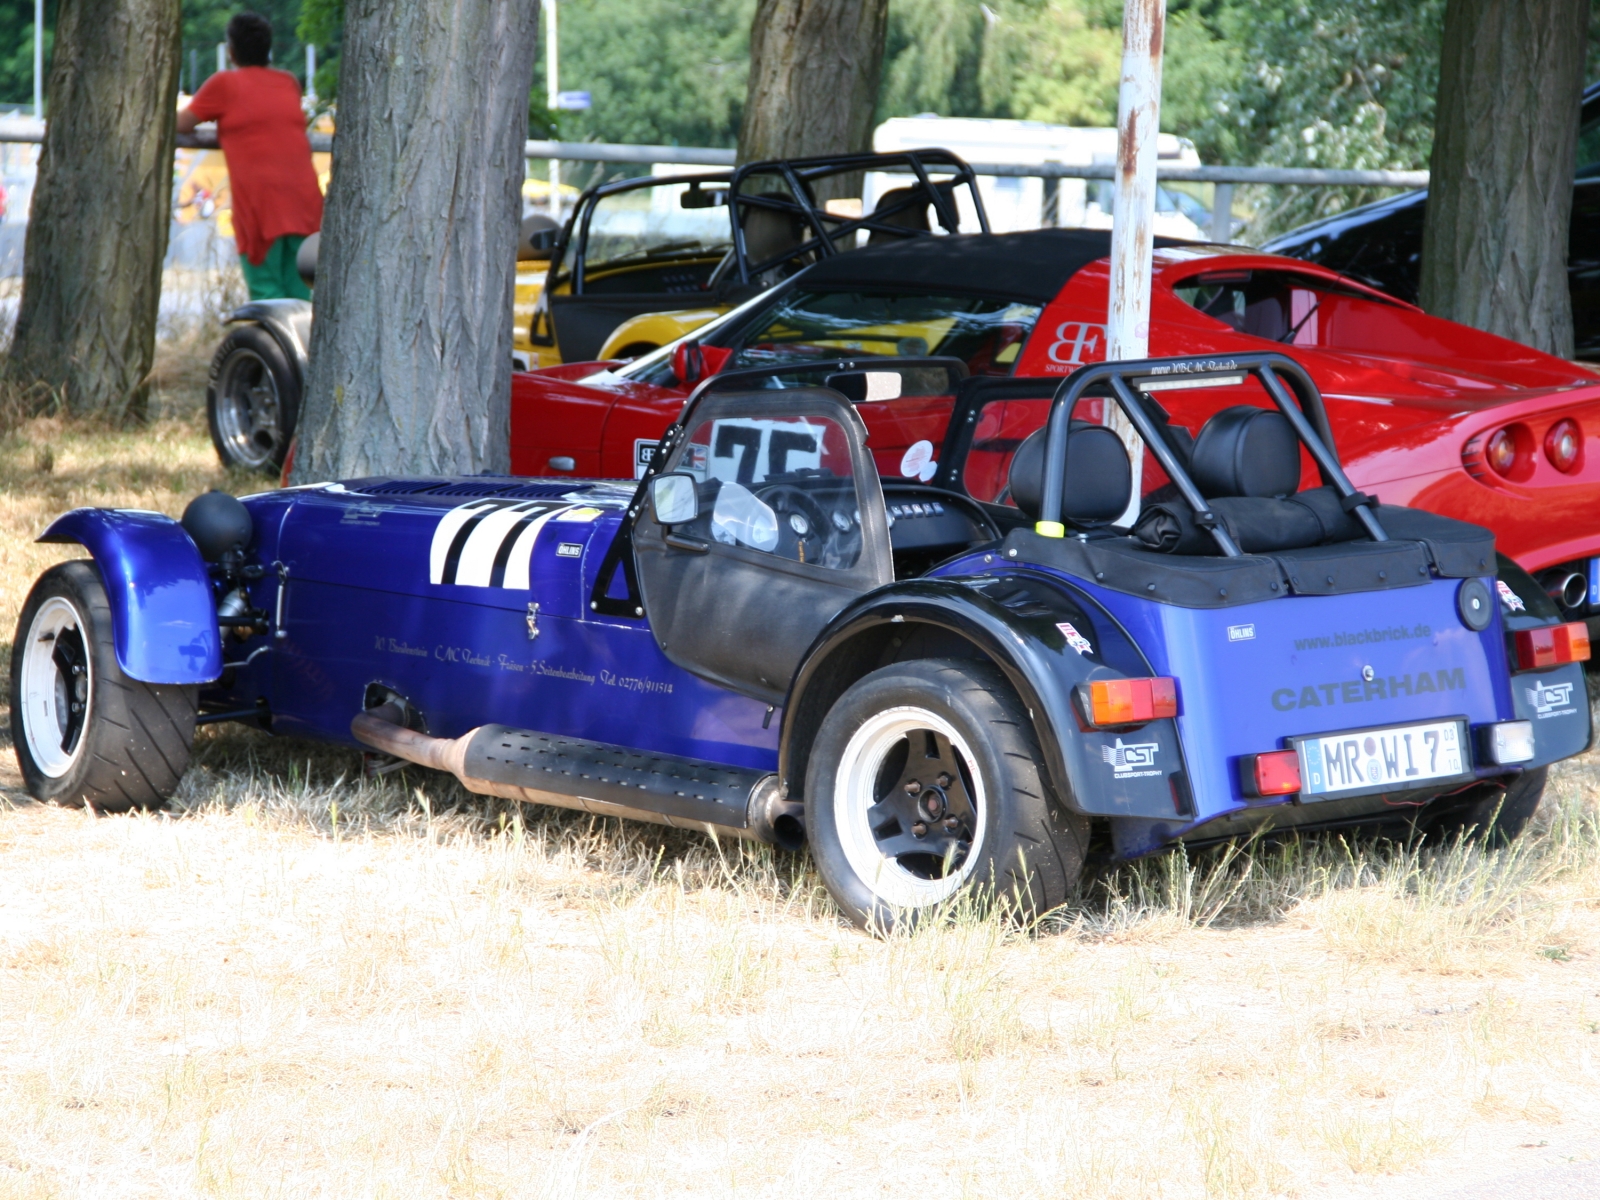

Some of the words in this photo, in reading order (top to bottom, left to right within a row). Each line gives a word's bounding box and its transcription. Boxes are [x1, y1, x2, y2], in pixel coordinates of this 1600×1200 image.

[1229, 626, 1255, 640] ÖHLINS
[1293, 622, 1432, 651] www.blackbrick.de
[434, 644, 461, 662] CNC
[462, 648, 491, 667] Technik
[1271, 667, 1466, 712] CATERHAM
[1324, 739, 1366, 787] MR
[1380, 733, 1420, 778] WI
[1424, 730, 1440, 773] 7
[1313, 771, 1321, 786] D
